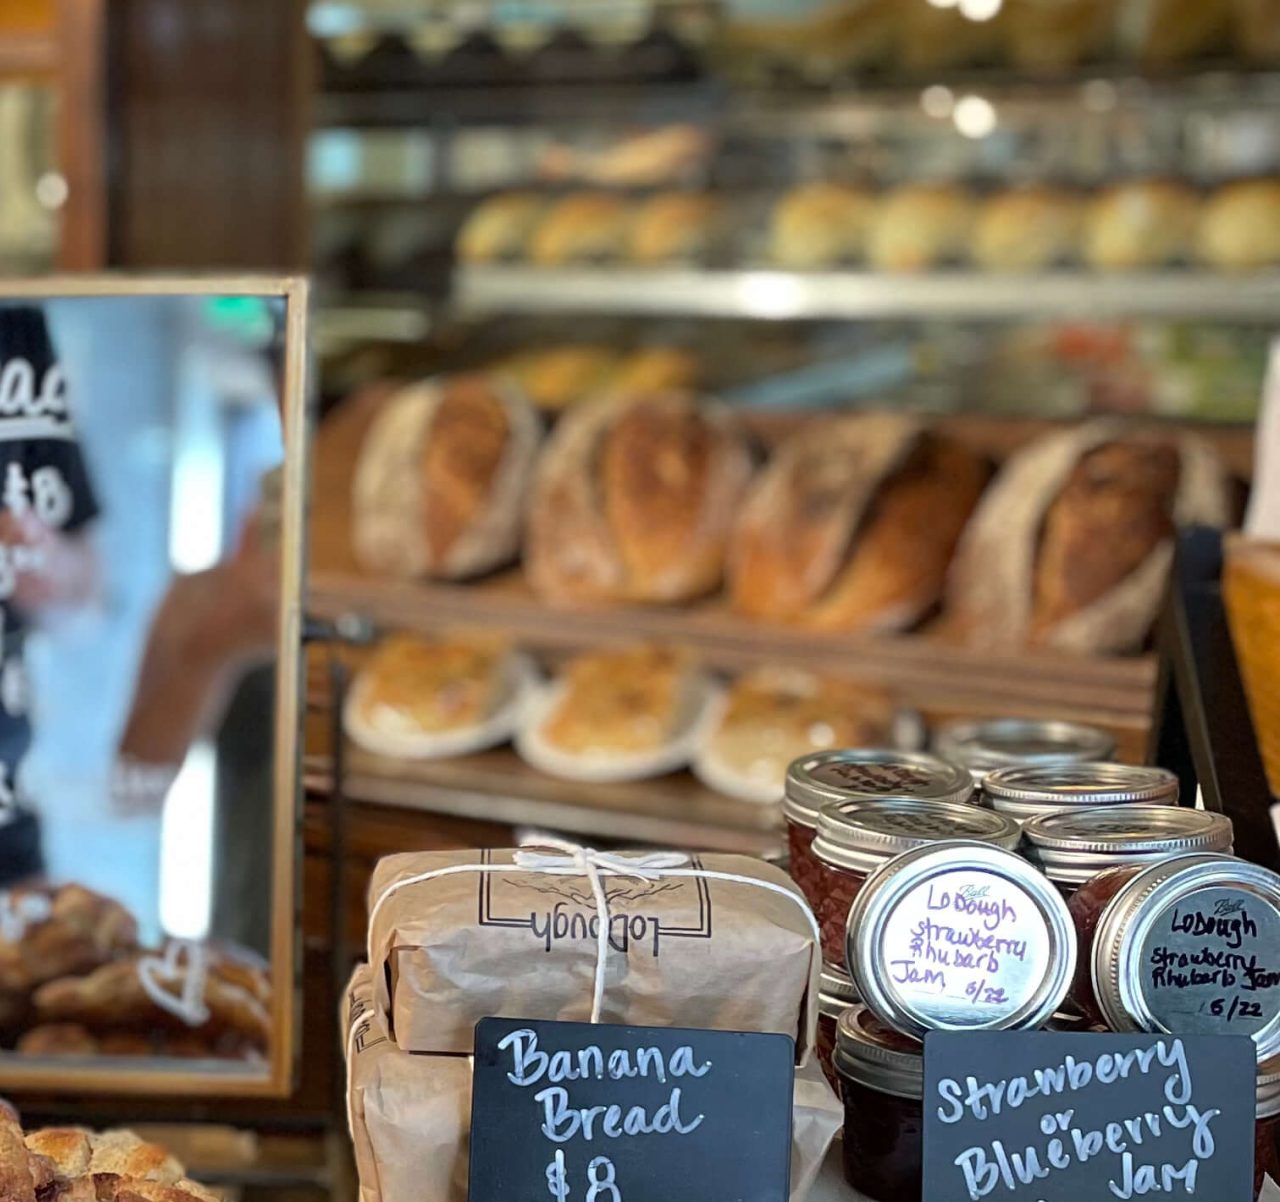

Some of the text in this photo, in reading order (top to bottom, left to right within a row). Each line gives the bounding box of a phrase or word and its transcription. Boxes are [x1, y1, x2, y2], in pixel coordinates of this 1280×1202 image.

[498, 1028, 712, 1086] Banana
[937, 1037, 1192, 1124] Strawberry
[534, 1086, 704, 1143] Bread
[1039, 1108, 1075, 1135] or
[953, 1104, 1221, 1201] Blueberry
